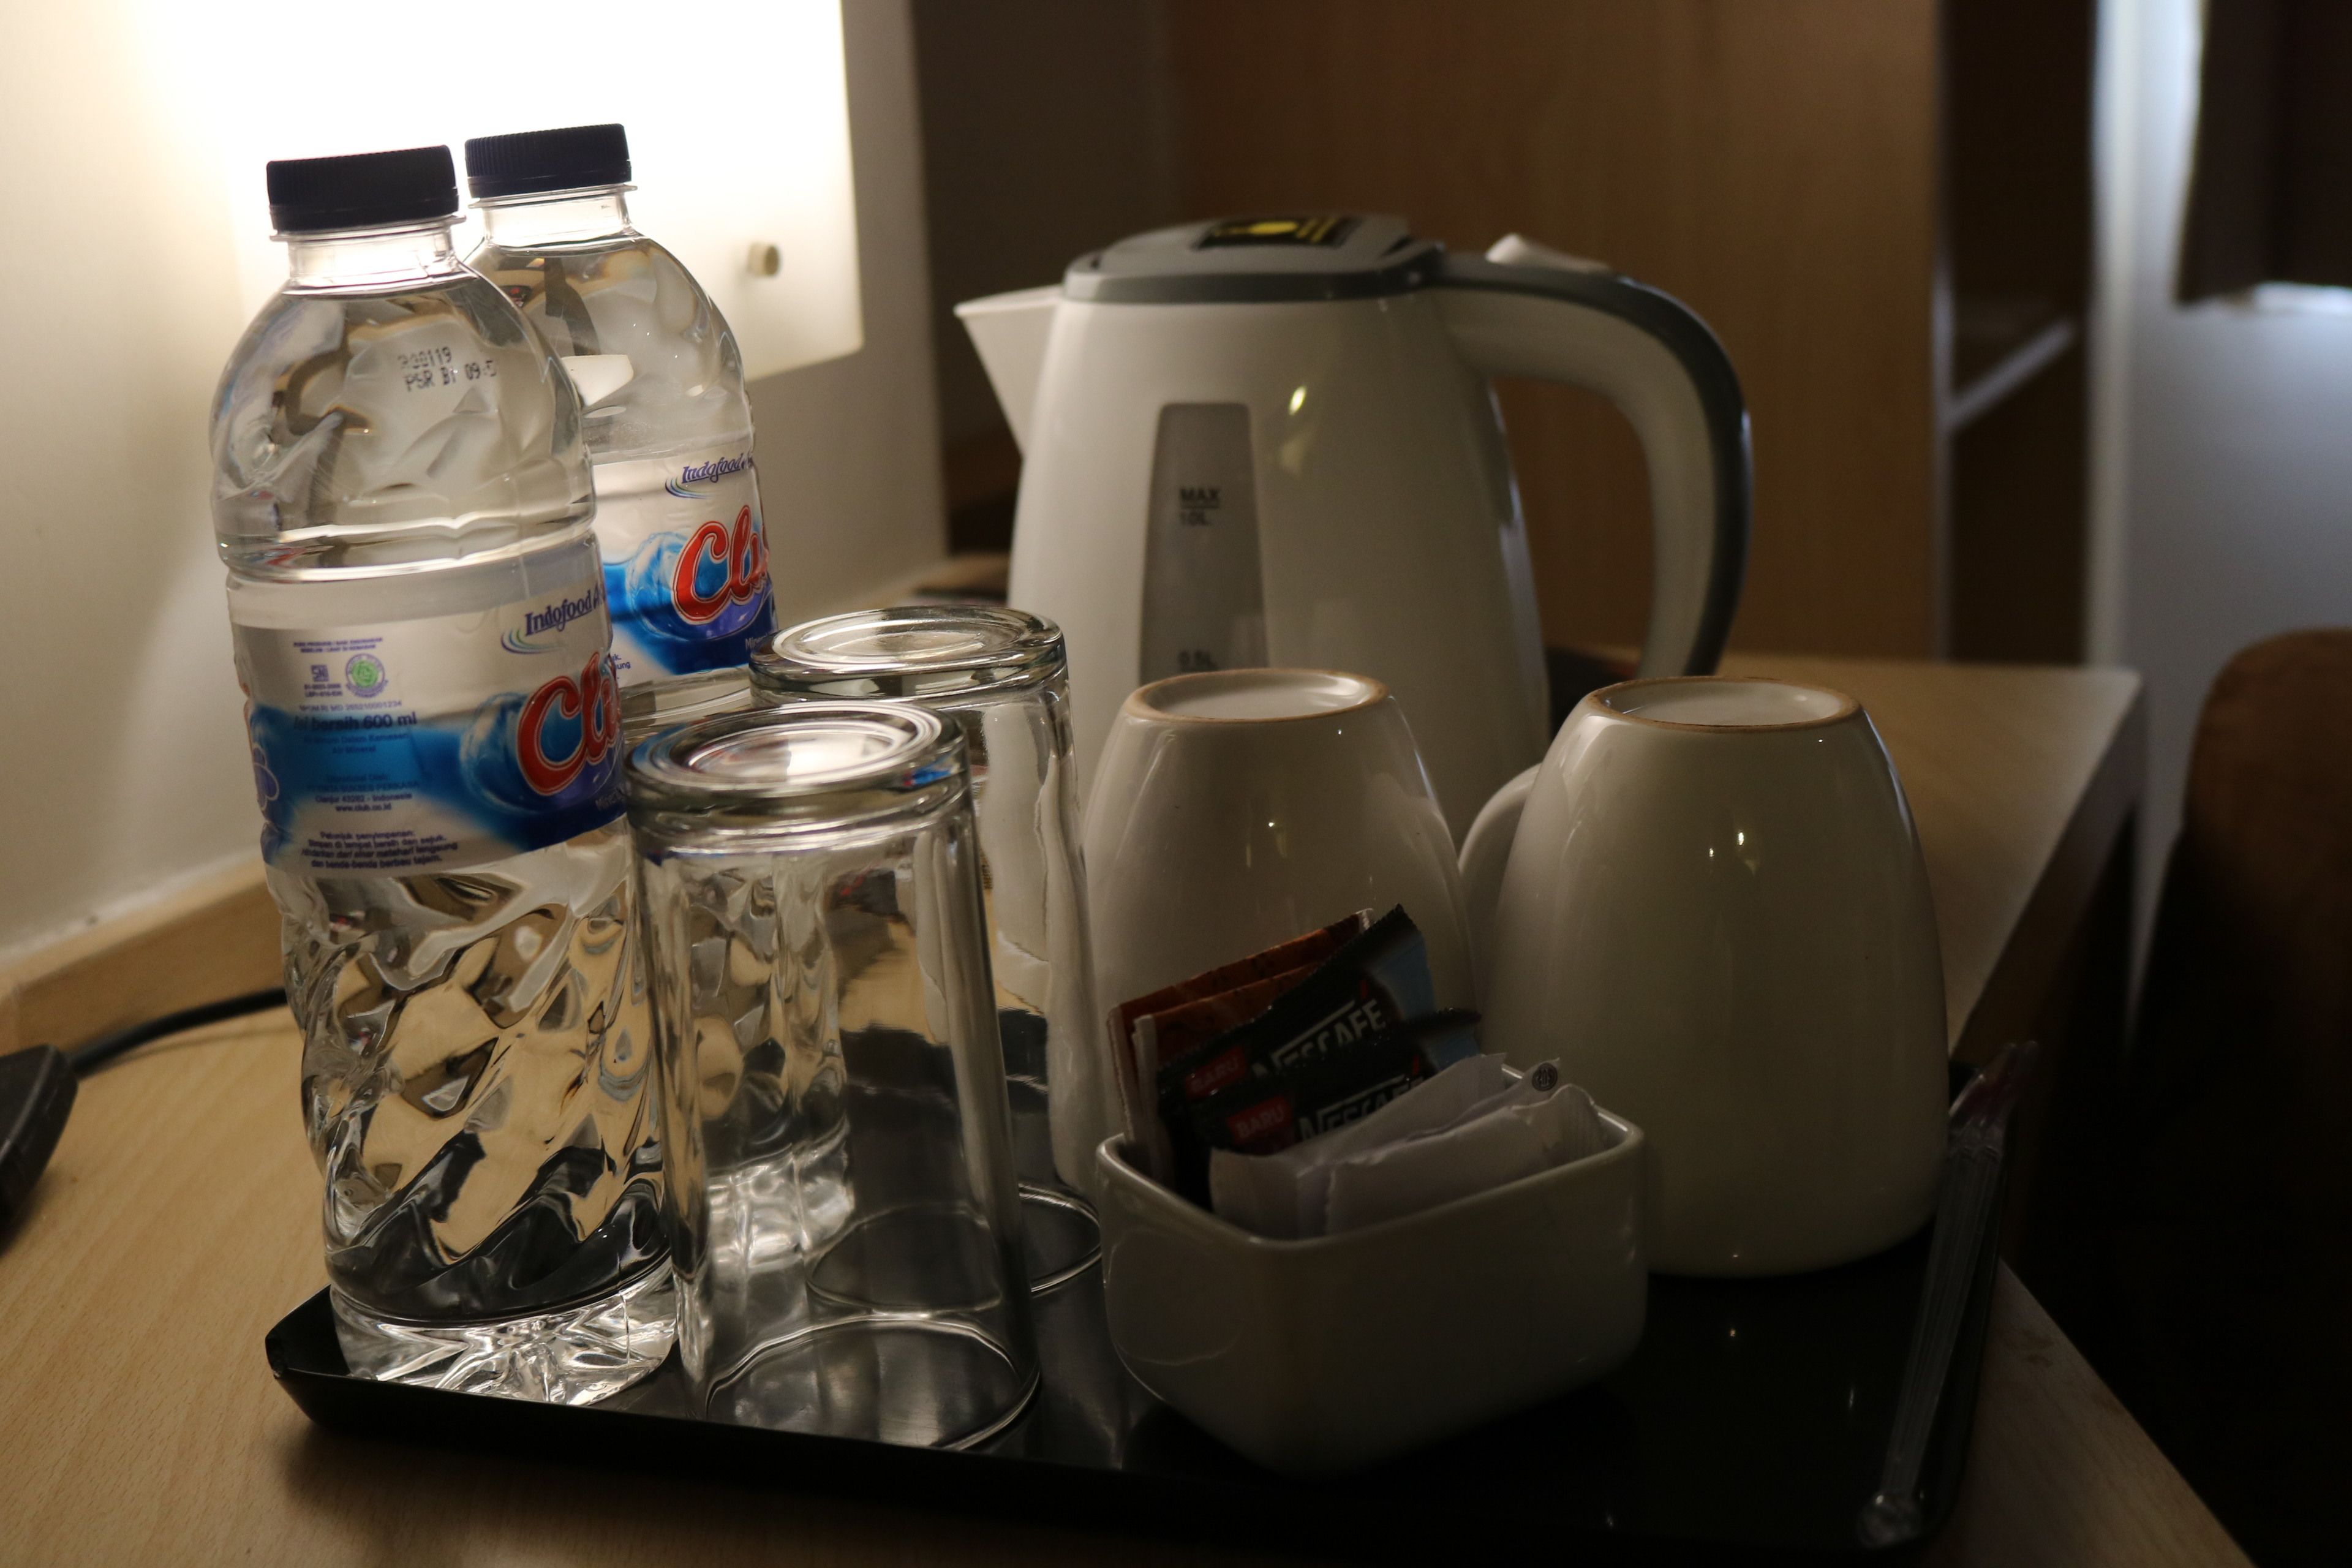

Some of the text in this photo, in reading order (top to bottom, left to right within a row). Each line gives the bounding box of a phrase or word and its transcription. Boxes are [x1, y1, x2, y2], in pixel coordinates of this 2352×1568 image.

[682, 453, 744, 483] Indofood
[1179, 488, 1219, 502] MAX
[525, 590, 593, 636] Indofood
[363, 714, 393, 729] 600
[398, 711, 417, 726] ml
[1190, 1055, 1240, 1091] BARU
[1235, 1106, 1286, 1139] BARU
